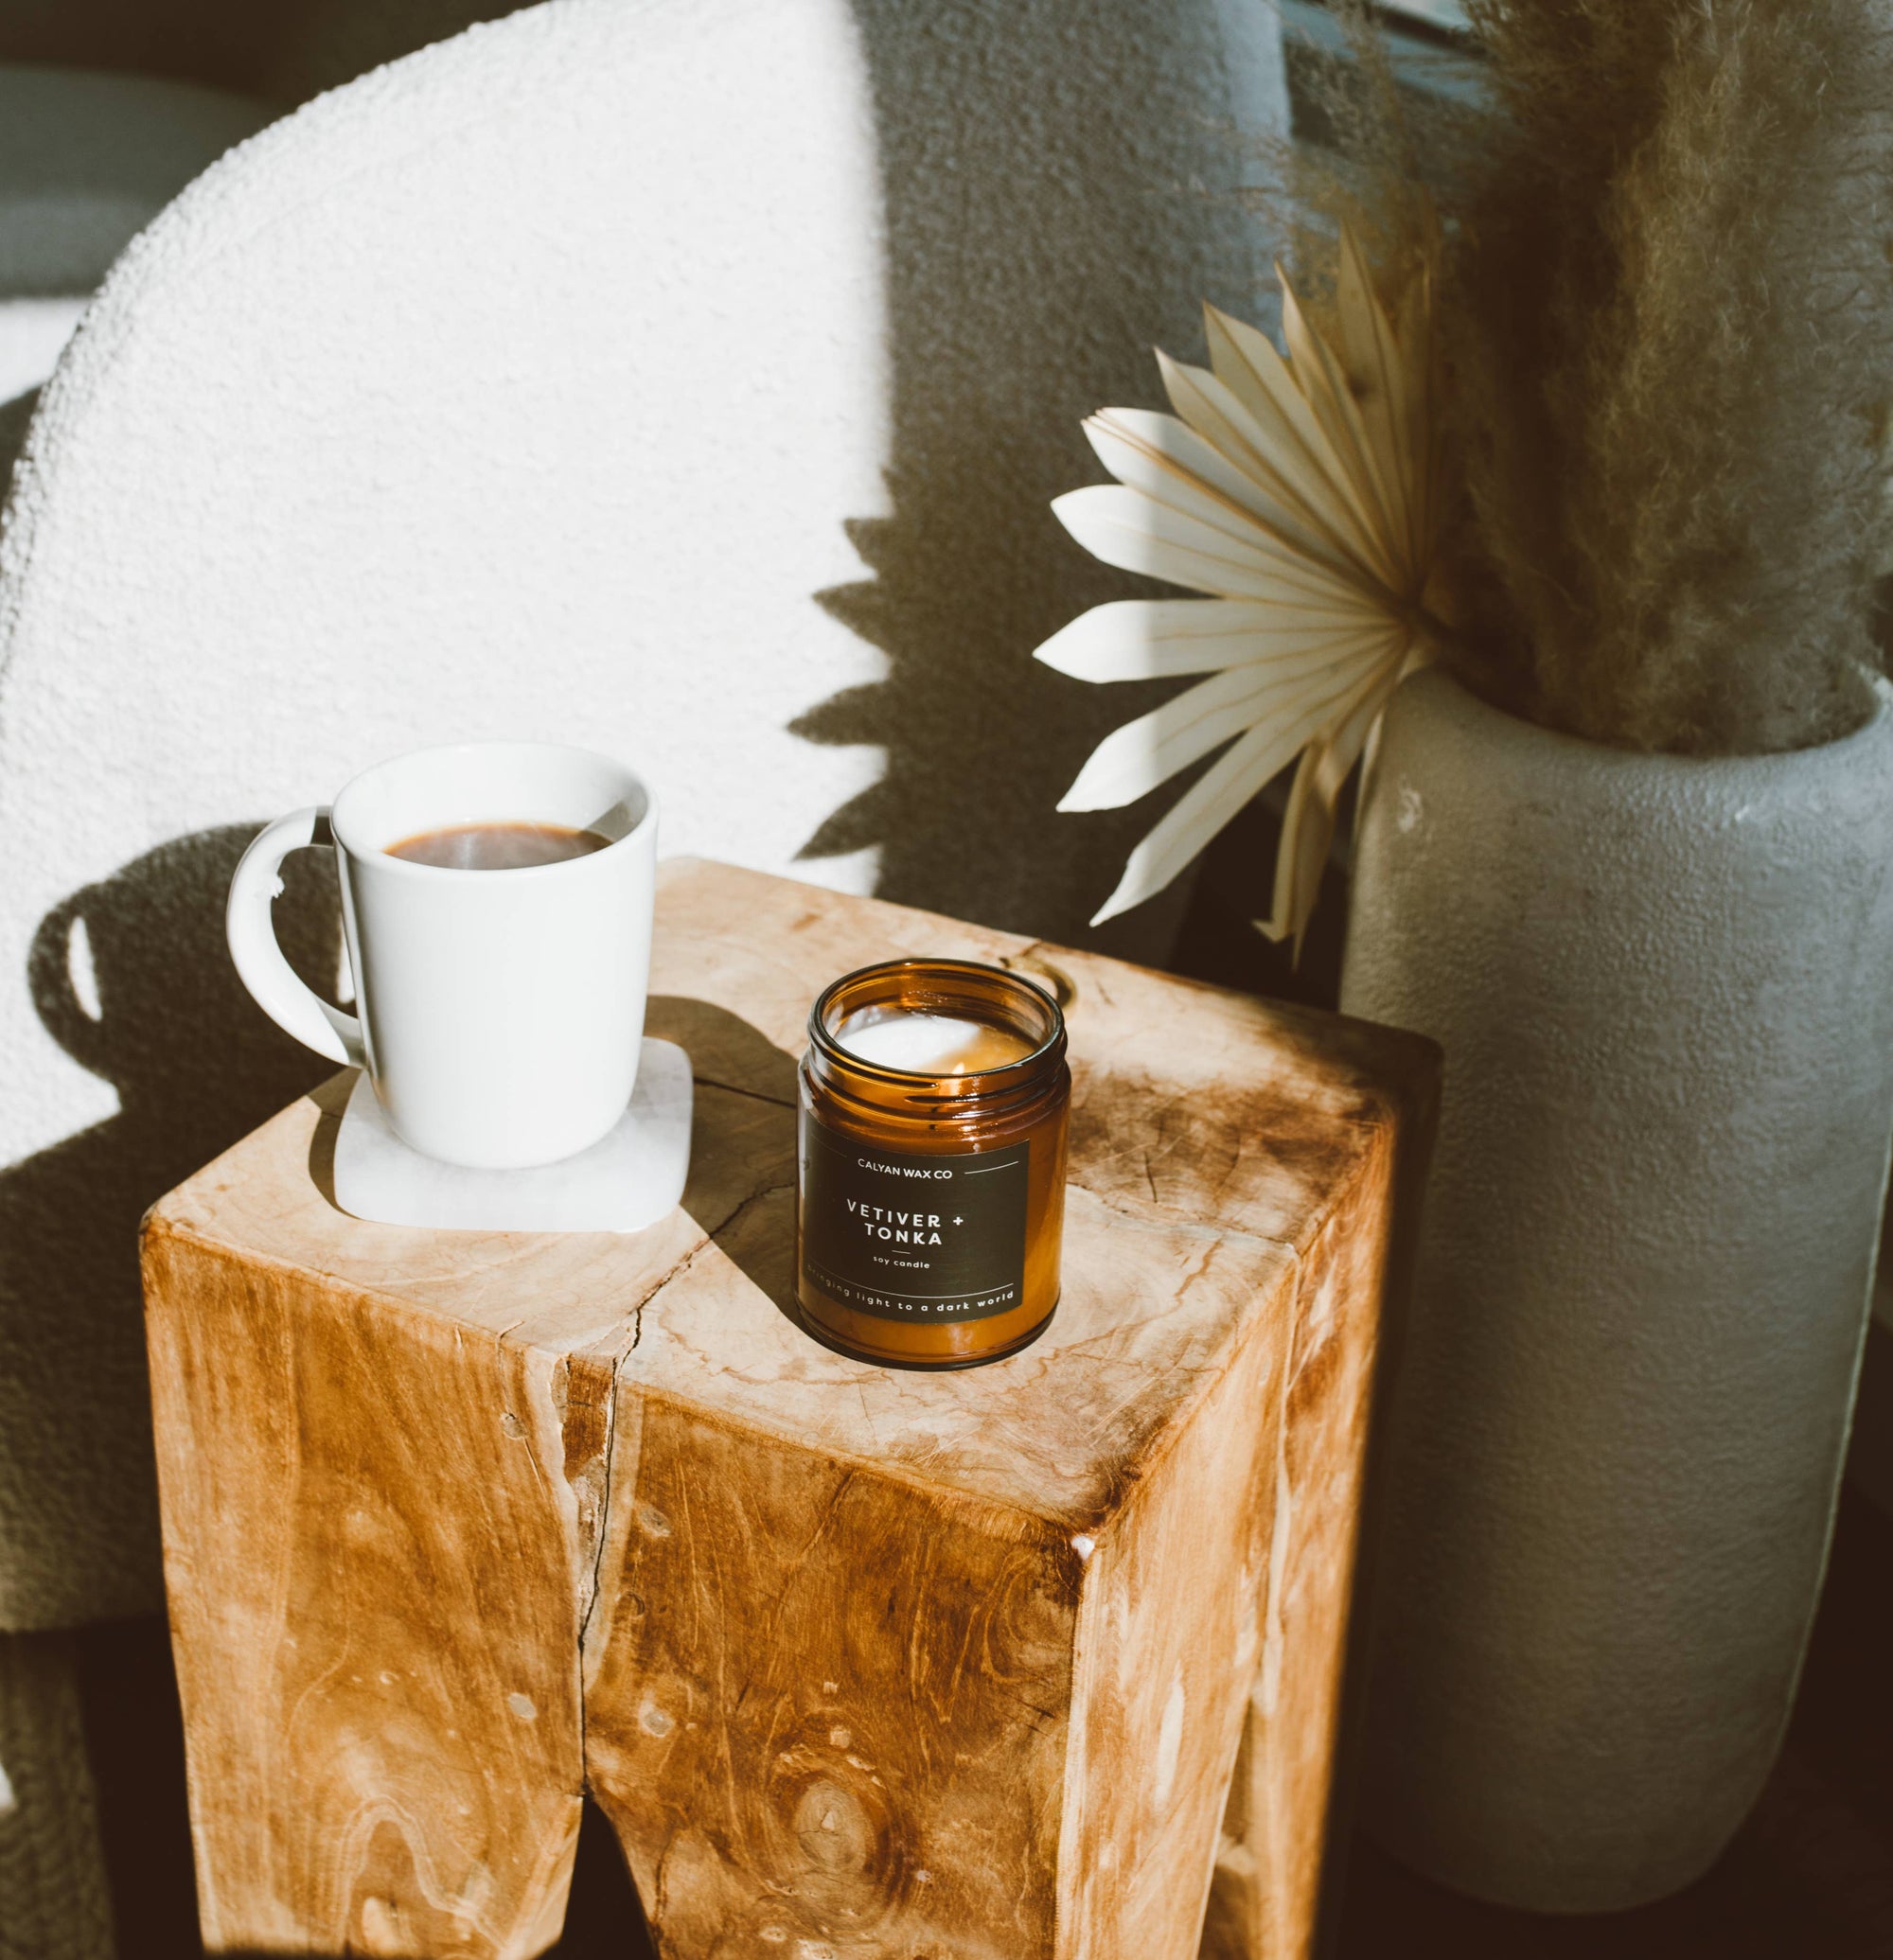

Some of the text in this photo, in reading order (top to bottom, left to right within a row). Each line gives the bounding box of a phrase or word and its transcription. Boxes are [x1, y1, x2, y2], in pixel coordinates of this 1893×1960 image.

[858, 1158, 953, 1179] CALYAN WAX CO
[847, 1198, 964, 1227] VETIVER +
[864, 1223, 942, 1245] TONKA
[873, 1256, 930, 1269] soy candle
[857, 1292, 891, 1308] light
[898, 1301, 912, 1311] to
[936, 1300, 970, 1312] dark
[977, 1291, 1014, 1308] world
